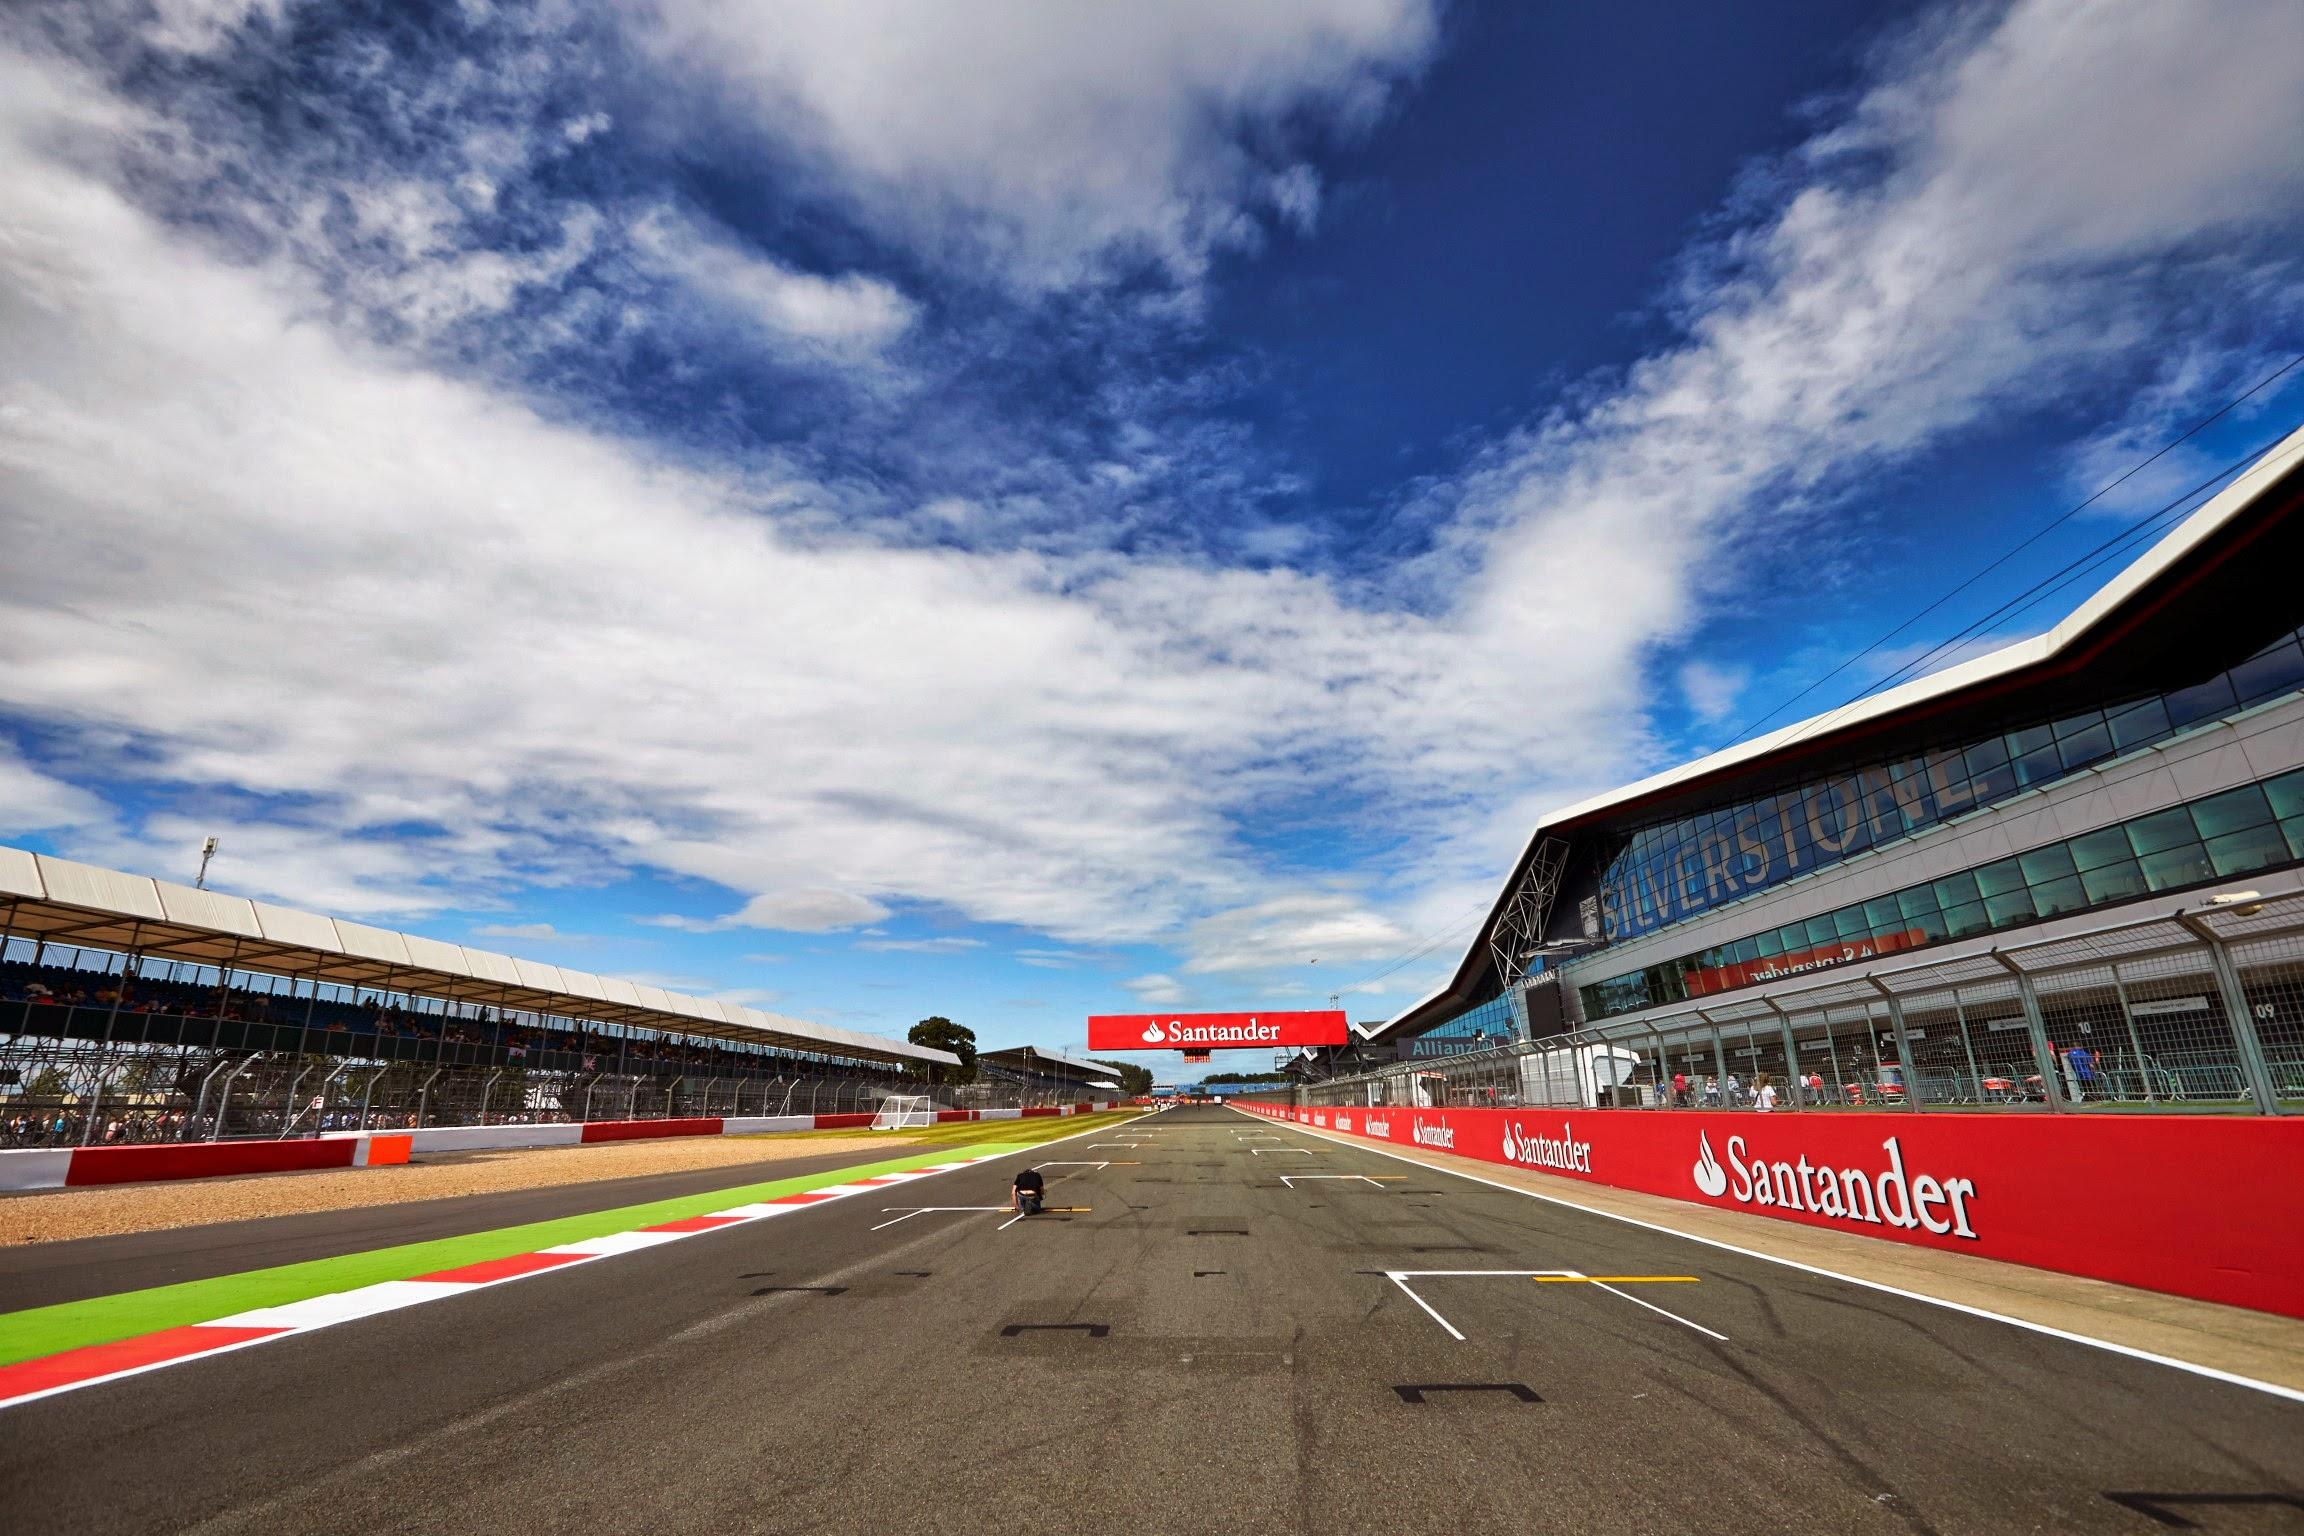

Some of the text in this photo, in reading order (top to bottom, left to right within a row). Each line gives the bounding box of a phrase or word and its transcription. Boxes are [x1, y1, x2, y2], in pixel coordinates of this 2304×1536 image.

[2255, 1003, 2275, 1019] 09
[1168, 1018, 1280, 1043] Santander
[2078, 1021, 2092, 1034] 10
[1412, 1039, 1473, 1056] Allianz
[1419, 1115, 1455, 1149] Santander
[1515, 1121, 1592, 1174] Santander
[1727, 1135, 1979, 1239] Santander
